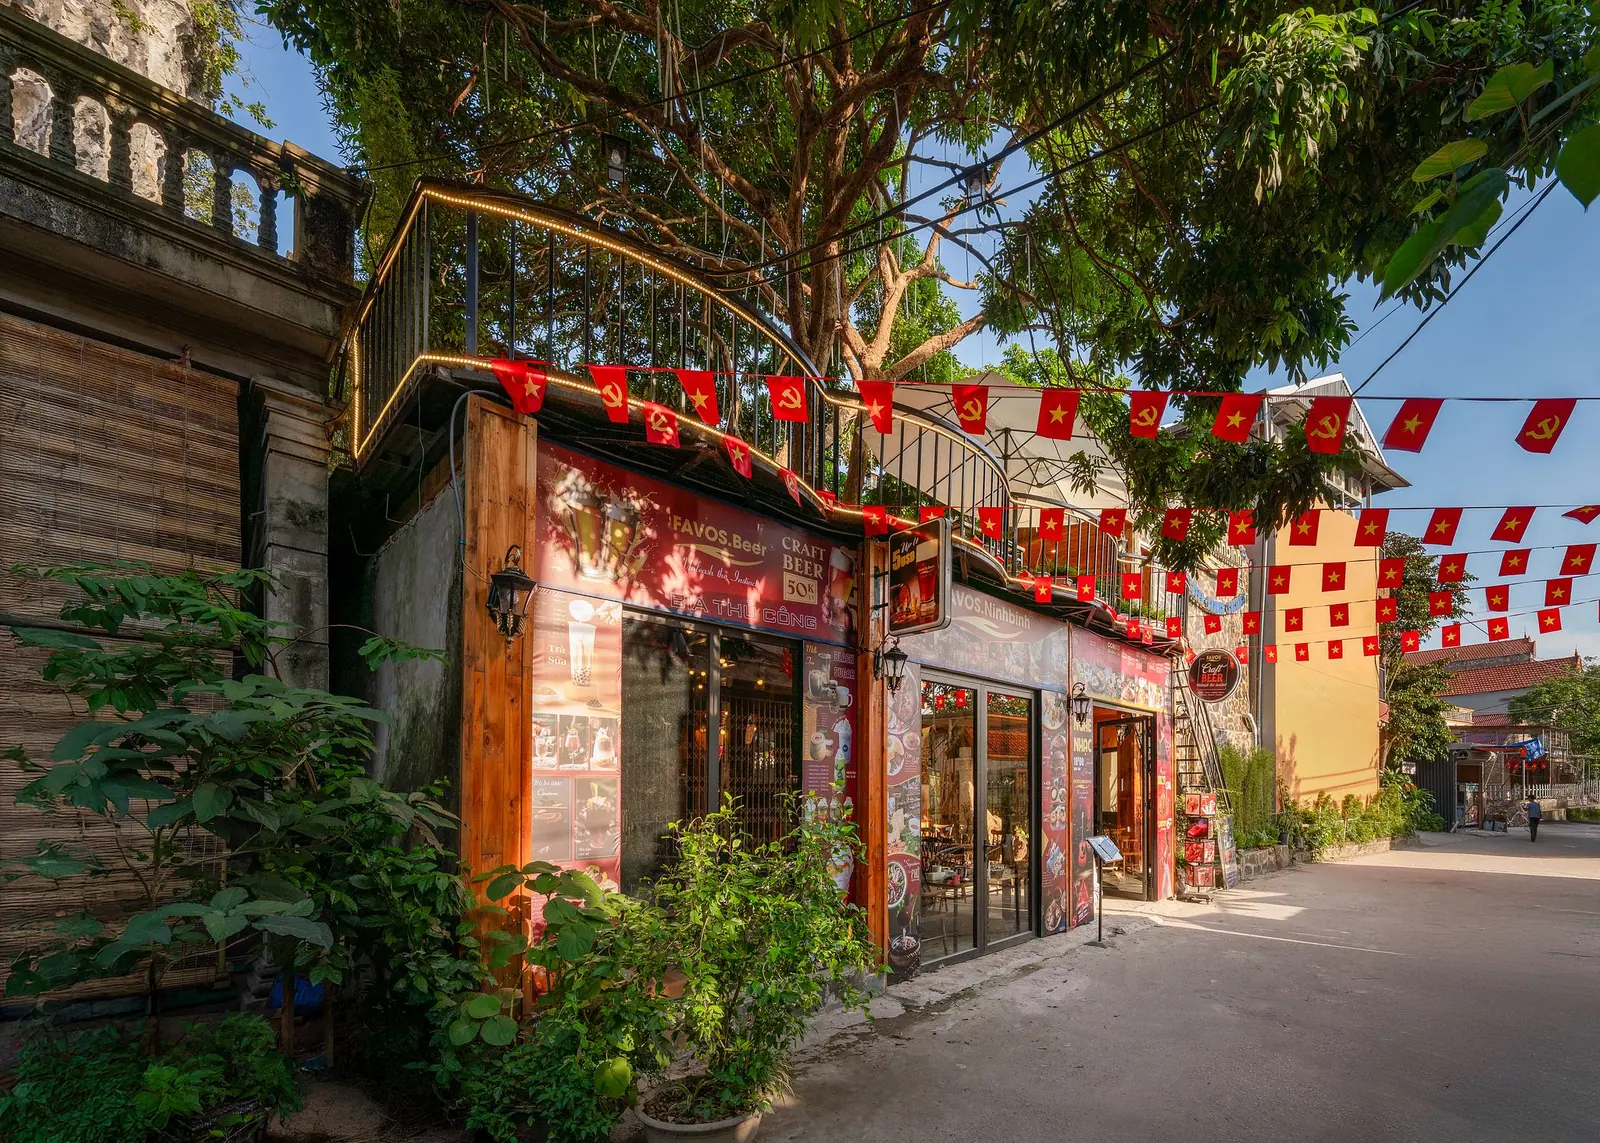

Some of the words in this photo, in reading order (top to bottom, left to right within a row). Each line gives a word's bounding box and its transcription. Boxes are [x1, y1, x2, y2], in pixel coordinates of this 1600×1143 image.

[673, 515, 767, 557] FAVOS.Beer
[782, 536, 826, 561] CRAFT
[782, 553, 823, 580] BEER
[763, 605, 817, 630] CÔNG
[951, 588, 1031, 630] AVOS.Ninhbinh
[547, 644, 566, 654] Trà
[547, 655, 567, 665] Sữa
[1201, 662, 1228, 675] Craft
[1201, 673, 1224, 683] BEER
